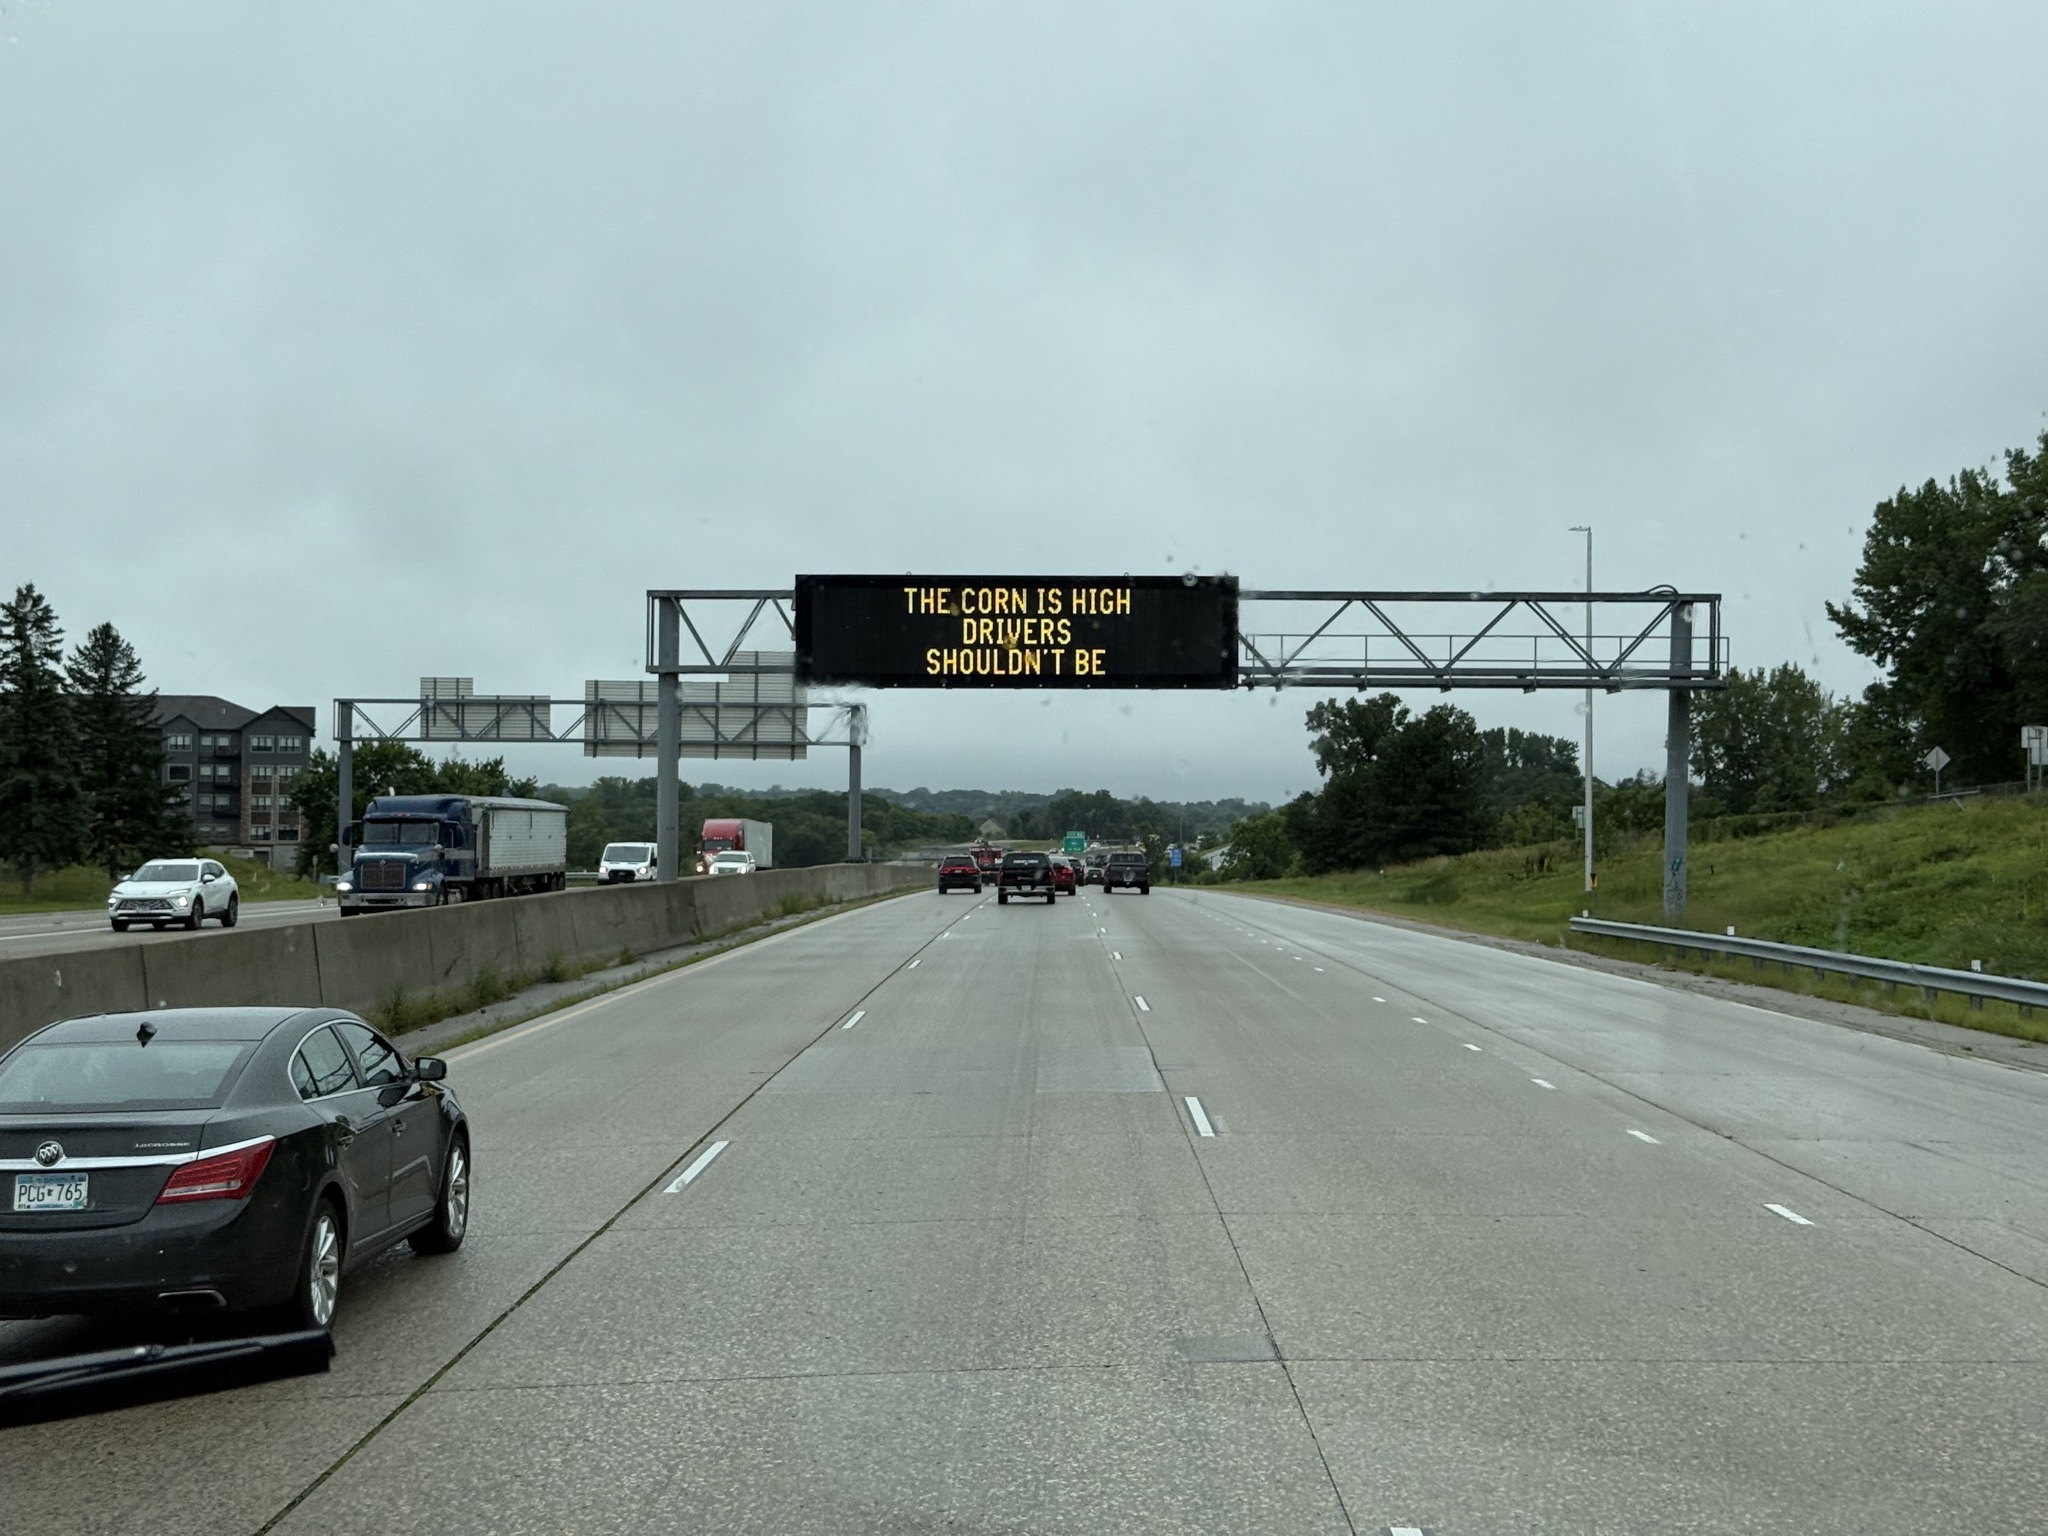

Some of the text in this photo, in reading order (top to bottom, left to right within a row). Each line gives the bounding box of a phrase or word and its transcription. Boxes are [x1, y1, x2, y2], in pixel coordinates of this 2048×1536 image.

[903, 587, 1131, 615] THE CORN IS HIGH
[962, 618, 1072, 645] DRIVERS
[926, 648, 1106, 676] SHOULDN'T BE
[18, 1183, 83, 1203] PCG 765
